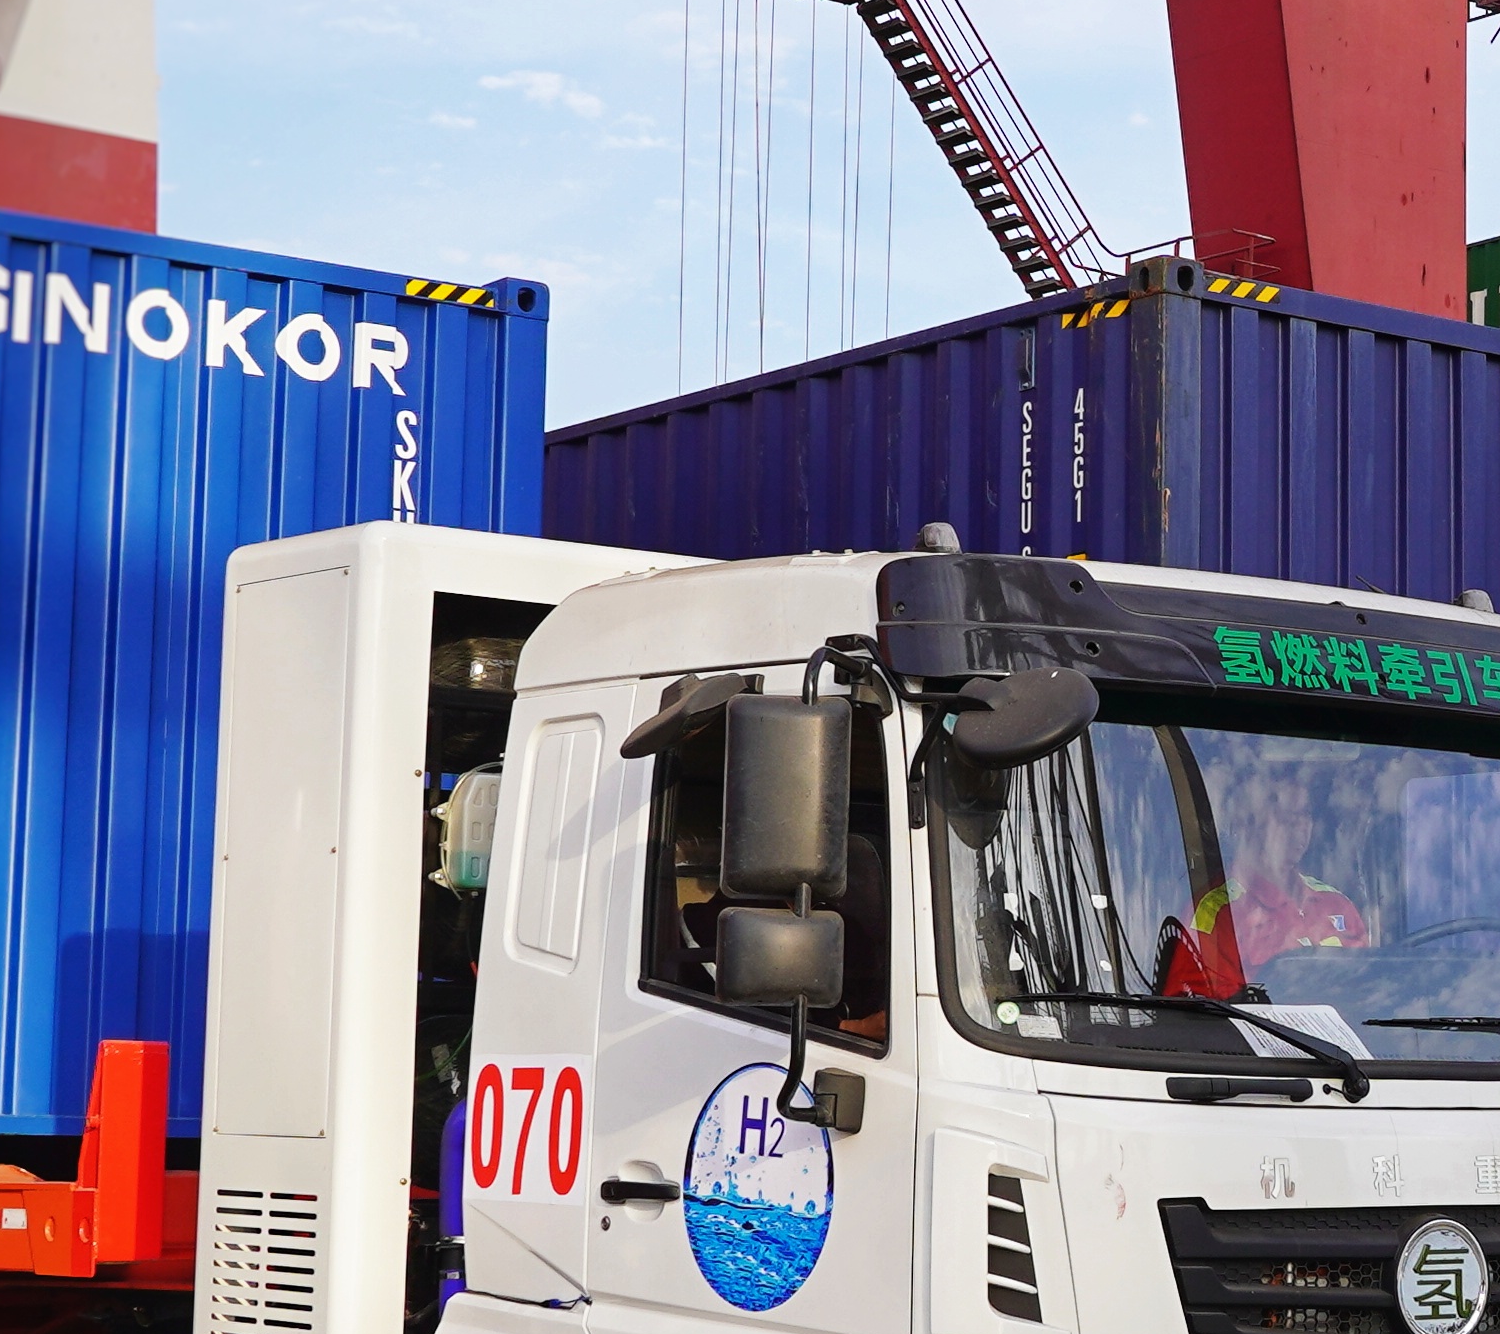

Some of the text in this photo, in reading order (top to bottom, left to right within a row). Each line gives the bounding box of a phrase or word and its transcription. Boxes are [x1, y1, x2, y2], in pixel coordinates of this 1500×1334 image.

[393, 410, 418, 523] SK
[1021, 401, 1033, 533] SEGU
[1073, 387, 1085, 523] 45G1
[470, 1063, 583, 1196] 070
[738, 1095, 786, 1158] H2
